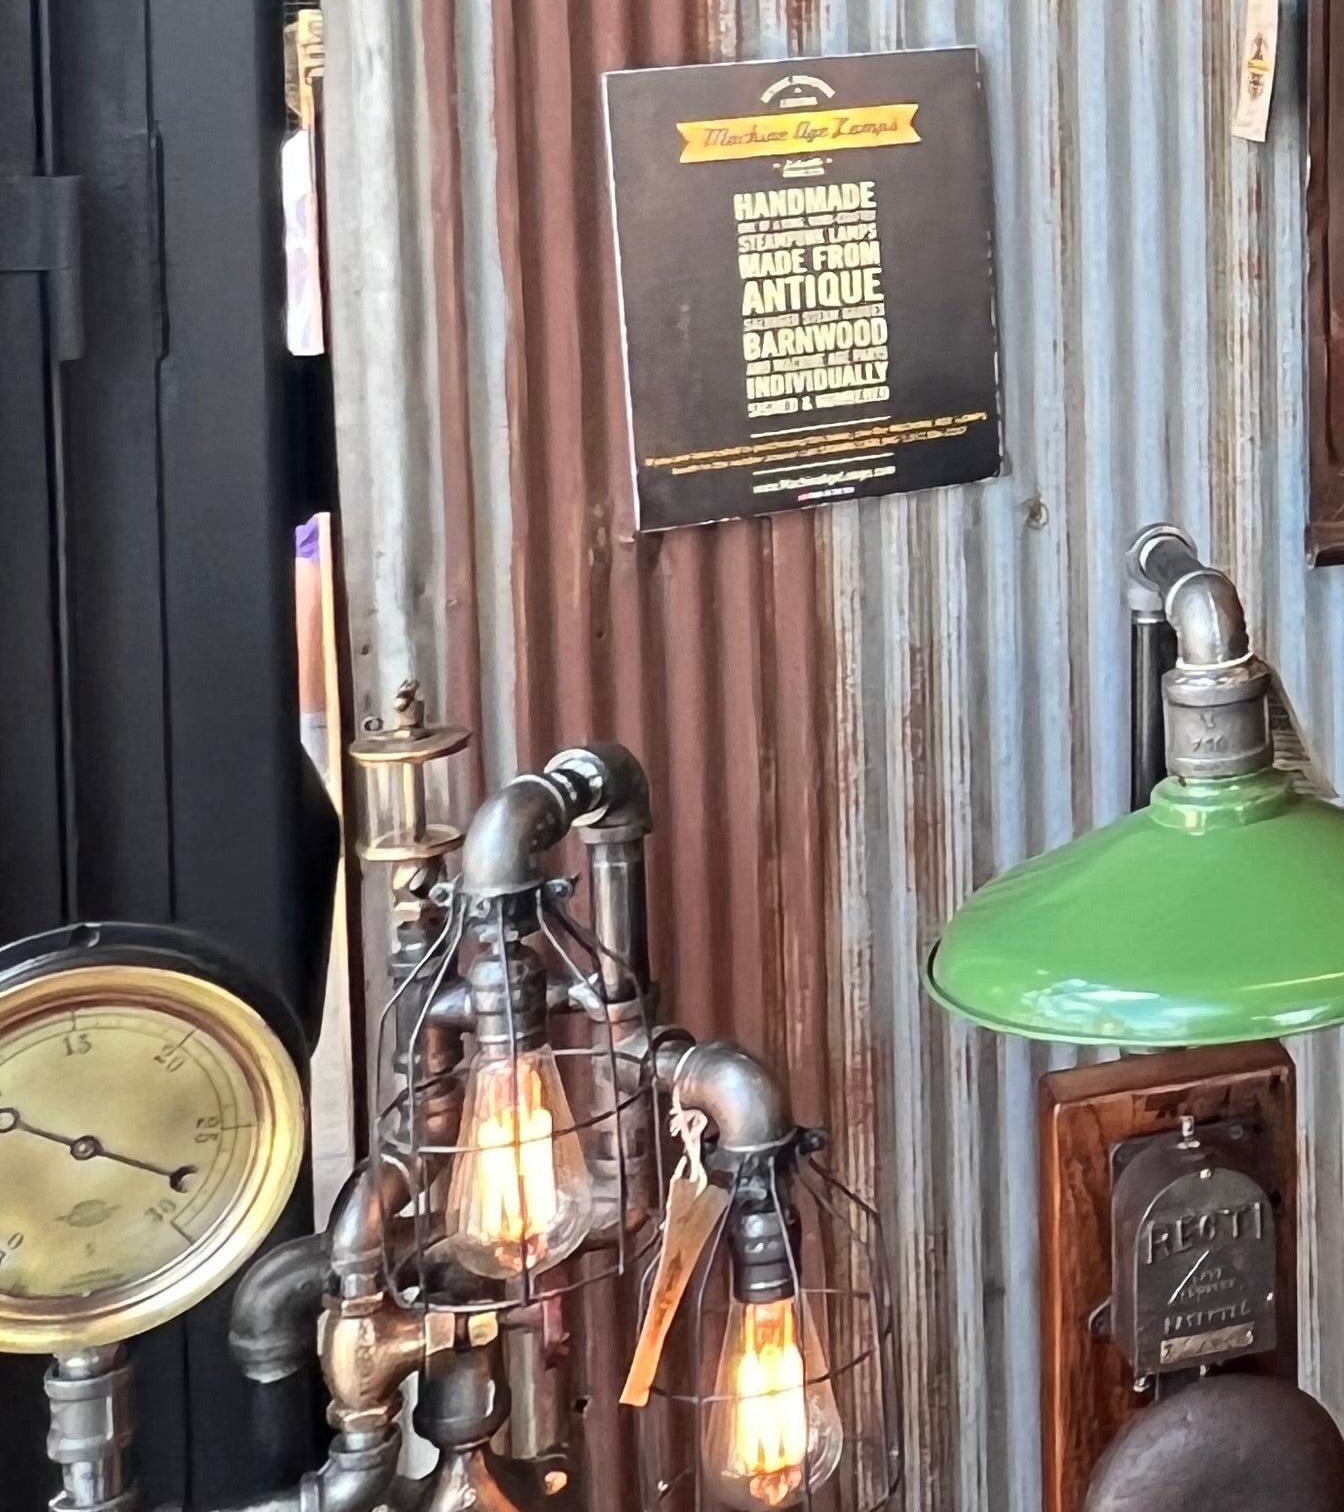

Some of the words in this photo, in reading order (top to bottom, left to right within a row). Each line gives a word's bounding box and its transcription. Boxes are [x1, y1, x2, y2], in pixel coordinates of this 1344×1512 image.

[704, 125, 788, 149] Machine
[793, 121, 829, 143] Age
[831, 117, 898, 139] Lamps
[733, 181, 877, 220] HANDMADE
[828, 222, 877, 243] LAMPS
[738, 248, 807, 279] MADE
[812, 241, 881, 271] FROM
[742, 268, 884, 316] ANTIQUE
[743, 318, 888, 361] BARNWOOD
[746, 361, 889, 399] INDIVIDUALLY
[62, 1033, 93, 1057] 15
